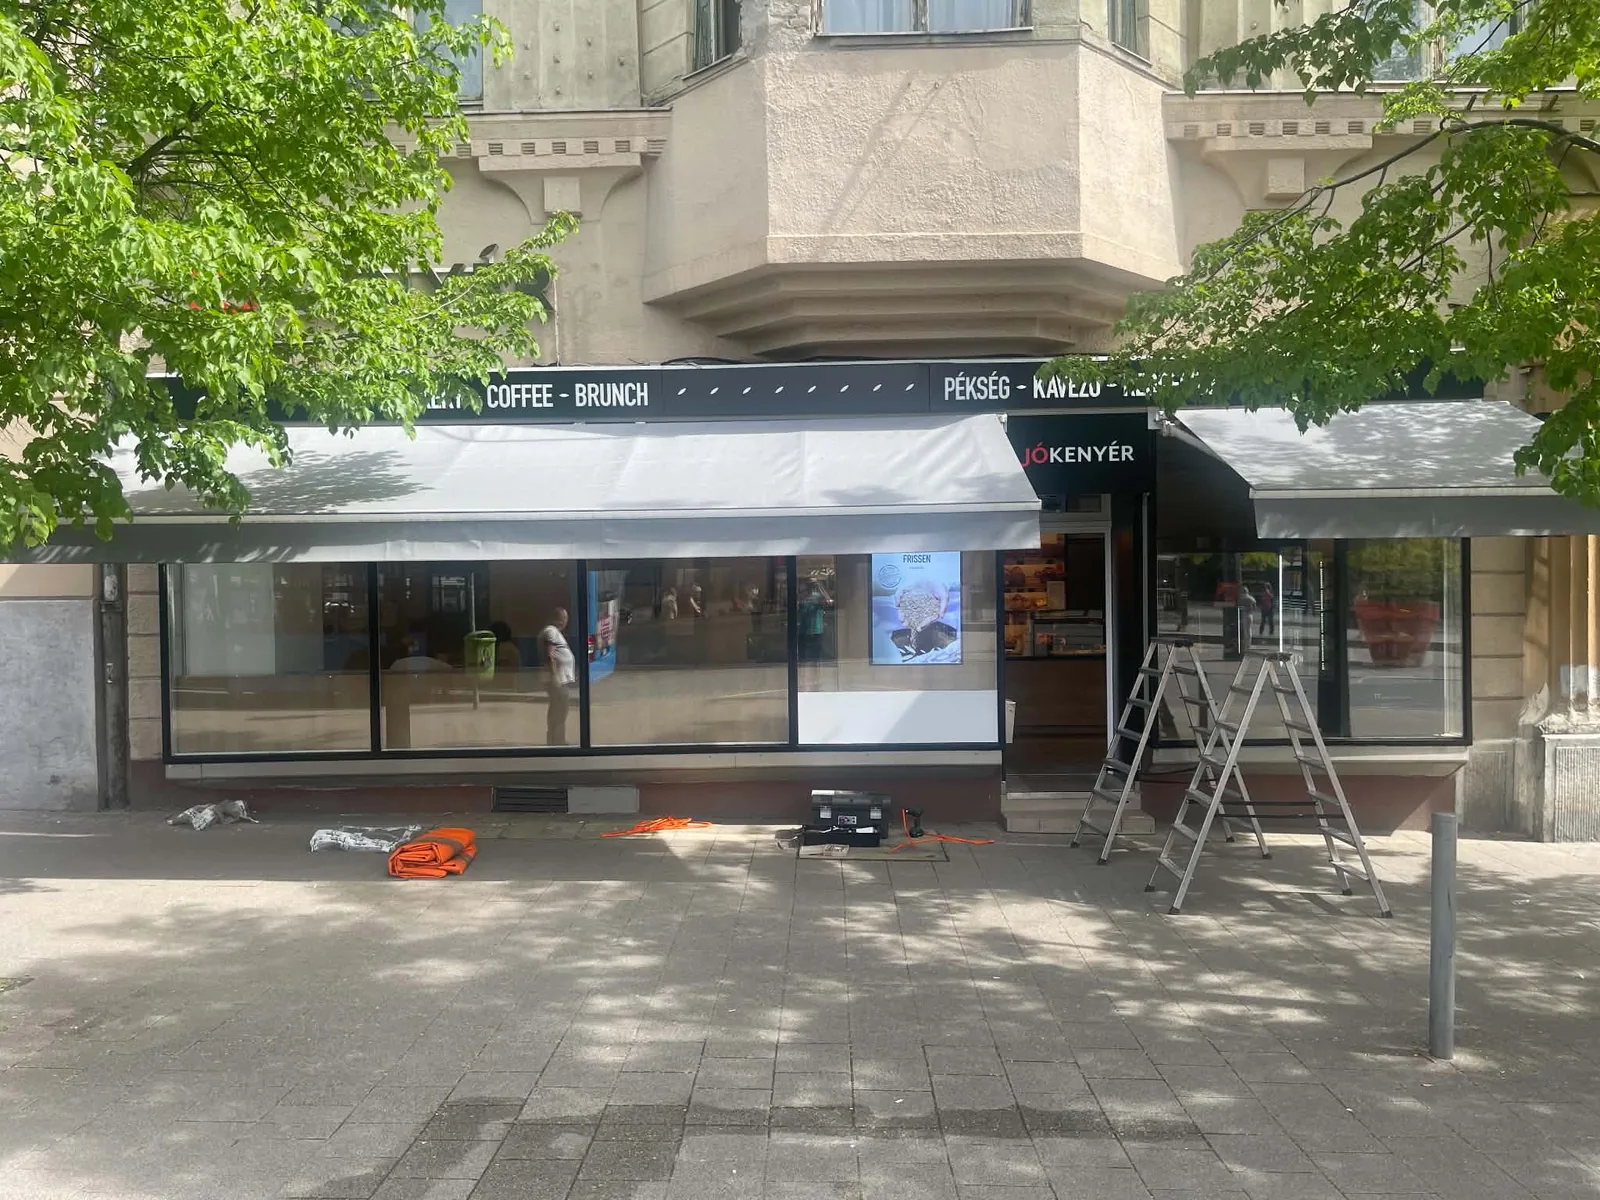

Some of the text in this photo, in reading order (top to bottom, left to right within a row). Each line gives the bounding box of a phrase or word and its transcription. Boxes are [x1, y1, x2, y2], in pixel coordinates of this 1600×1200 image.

[486, 384, 553, 408] COFFEE
[575, 383, 648, 407] BRUNCH
[944, 370, 1010, 400] PÉKSÉG
[1021, 440, 1135, 468] JÓKENYÉR
[903, 554, 931, 563] FRISSEN
